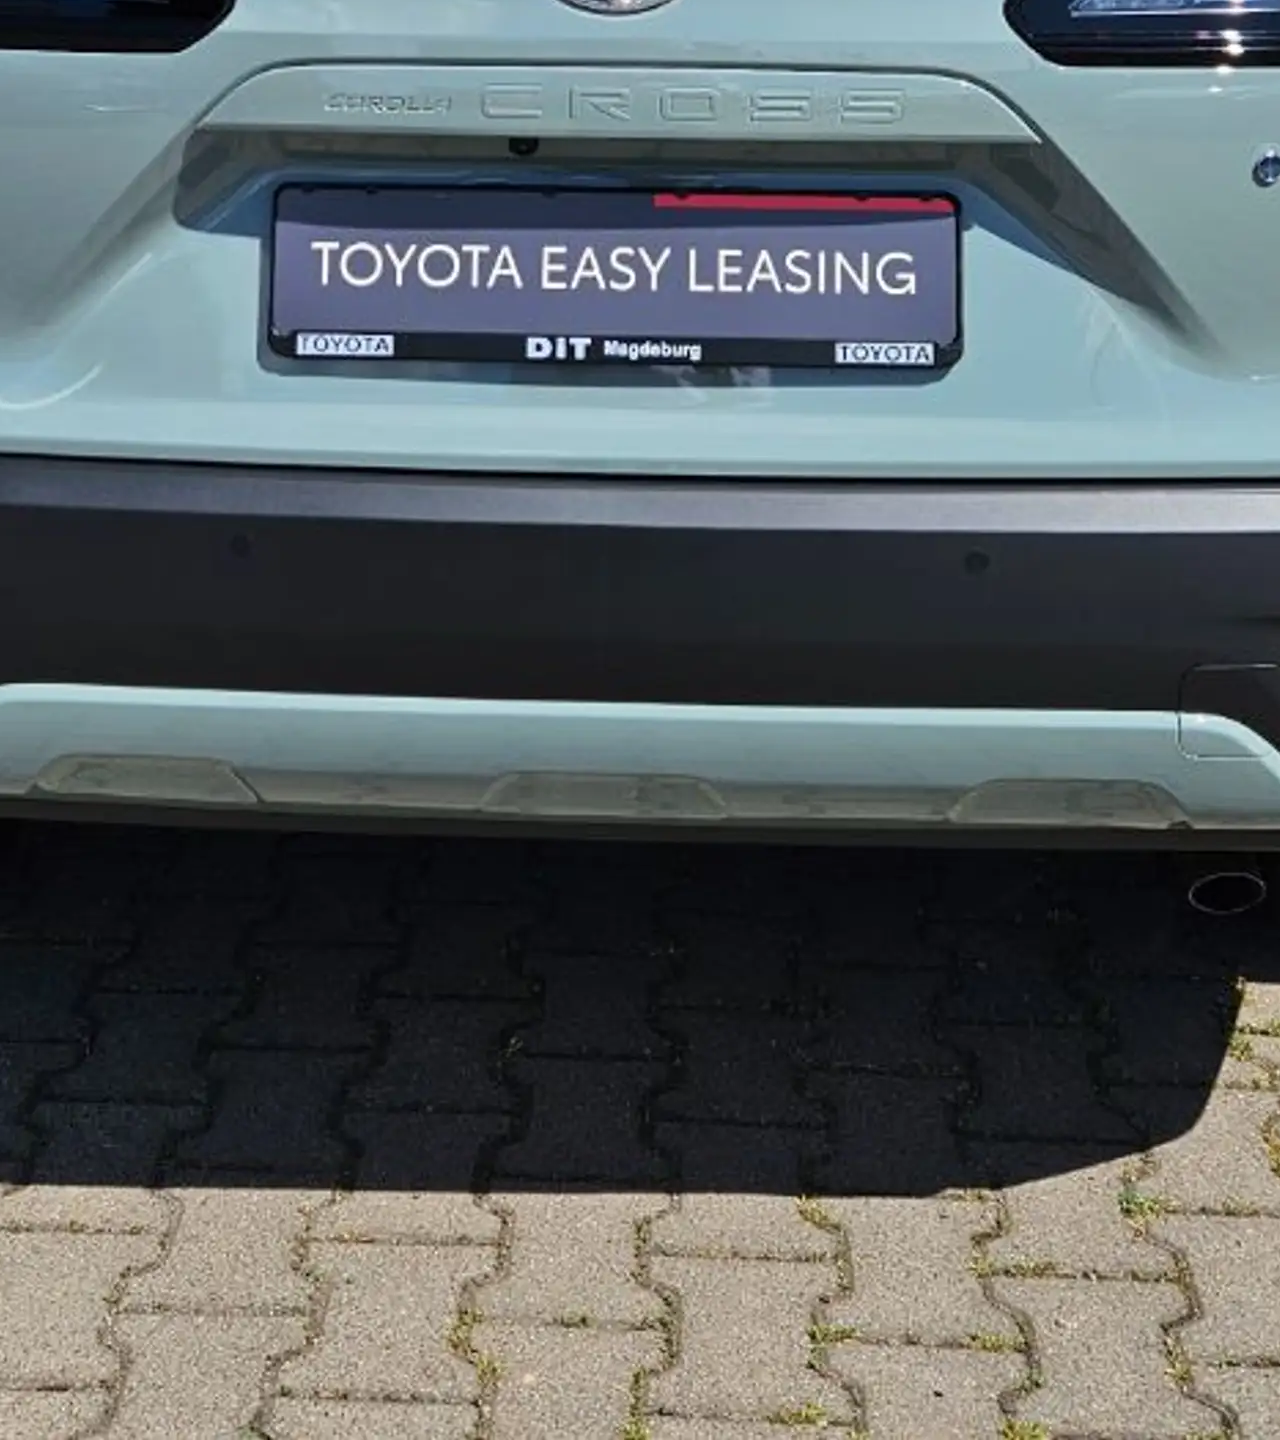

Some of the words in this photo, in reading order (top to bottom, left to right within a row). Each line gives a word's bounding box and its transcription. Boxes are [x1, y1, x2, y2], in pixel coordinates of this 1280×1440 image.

[481, 82, 906, 123] CROSS
[311, 241, 523, 288] TOYOTA
[541, 246, 671, 291] EASY
[689, 248, 917, 295] LEASING
[300, 335, 390, 354] TOYOTA
[526, 336, 592, 360] DIT
[604, 340, 702, 362] Magdeburg
[839, 344, 931, 362] TOYOTA
